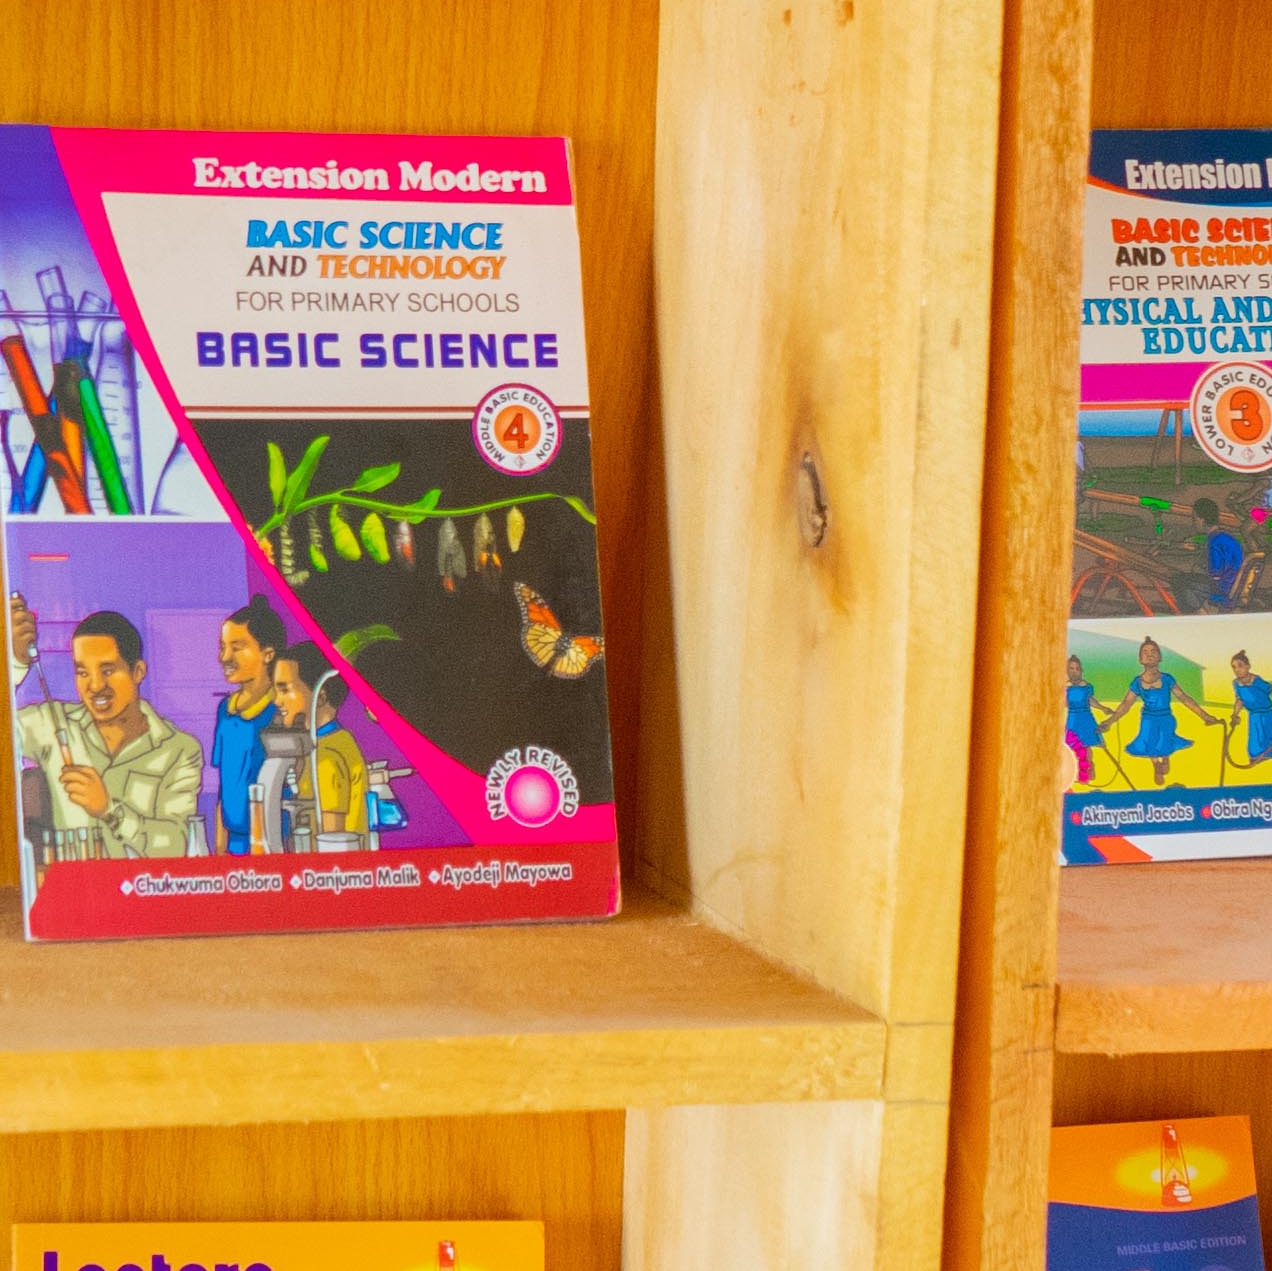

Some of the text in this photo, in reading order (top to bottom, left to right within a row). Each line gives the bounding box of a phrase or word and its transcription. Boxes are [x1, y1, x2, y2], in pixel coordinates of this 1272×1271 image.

[193, 158, 548, 193] Extension Modern
[1125, 159, 1261, 190] Extension
[246, 219, 504, 250] BASIC SCIENCE
[1112, 218, 1199, 243] BASIC
[246, 254, 506, 280] AND TECHNOLOGY
[1116, 246, 1166, 267] AND
[1109, 275, 1149, 291] FOR
[1158, 274, 1250, 291] PRIMARY
[235, 291, 520, 313] FOR PRIMARY SCHOOLS
[197, 332, 559, 368] BASIC SCIENCE
[1205, 371, 1243, 400] BASIC
[481, 392, 555, 462] MIDDLE BASIC EDUCATION
[1230, 390, 1263, 441] 3
[503, 413, 529, 449] 4
[1202, 405, 1234, 456] LOWER
[488, 746, 578, 820] NEWLY REVISED
[1082, 805, 1194, 829] Akinyemi Jacobs
[1212, 802, 1250, 818] Obira
[135, 870, 282, 894] Chukwuma Obiora
[304, 866, 420, 894] Danjuma Malik
[442, 862, 572, 886] Ayodeji Mayowa
